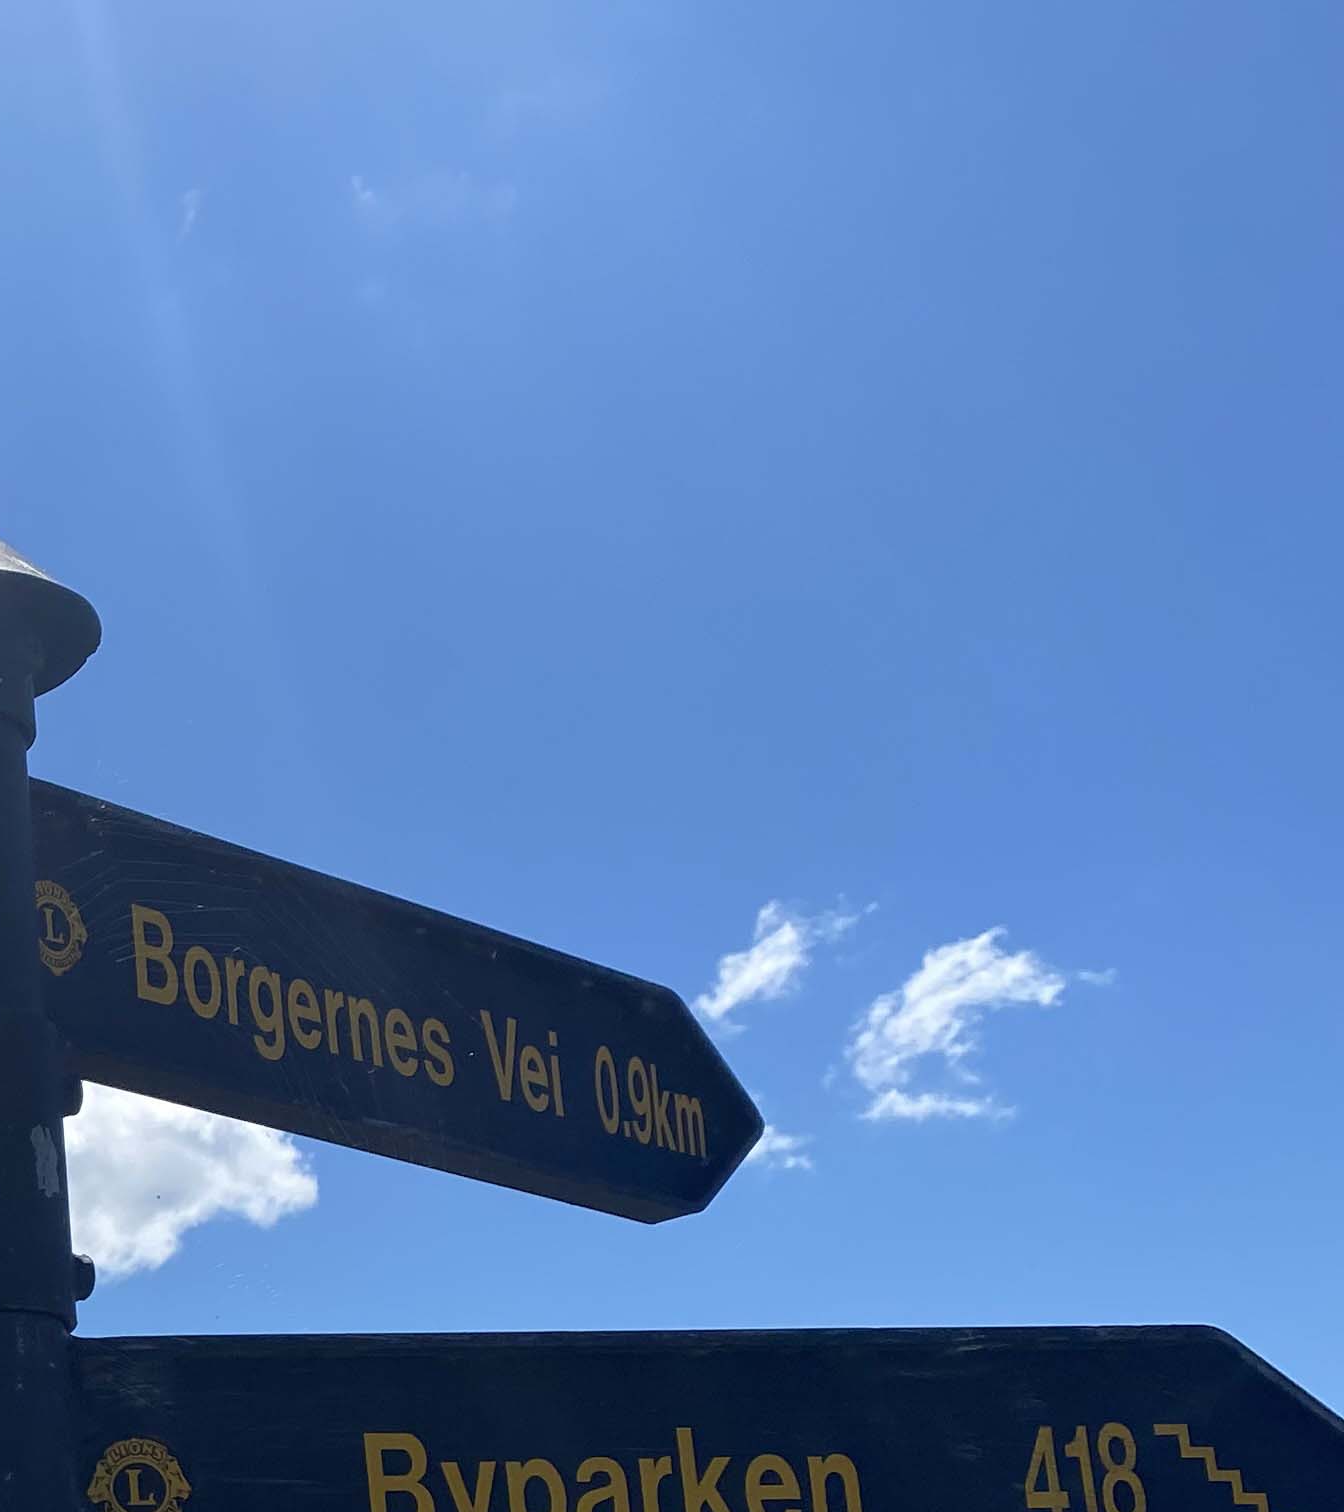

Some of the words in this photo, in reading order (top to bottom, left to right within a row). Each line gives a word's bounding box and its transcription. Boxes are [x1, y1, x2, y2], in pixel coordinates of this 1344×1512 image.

[131, 904, 454, 1087] Borgernes
[481, 1010, 564, 1116] Vei
[595, 1045, 706, 1157] 0.9km
[110, 1441, 168, 1462] LIONS
[126, 1469, 156, 1505] L
